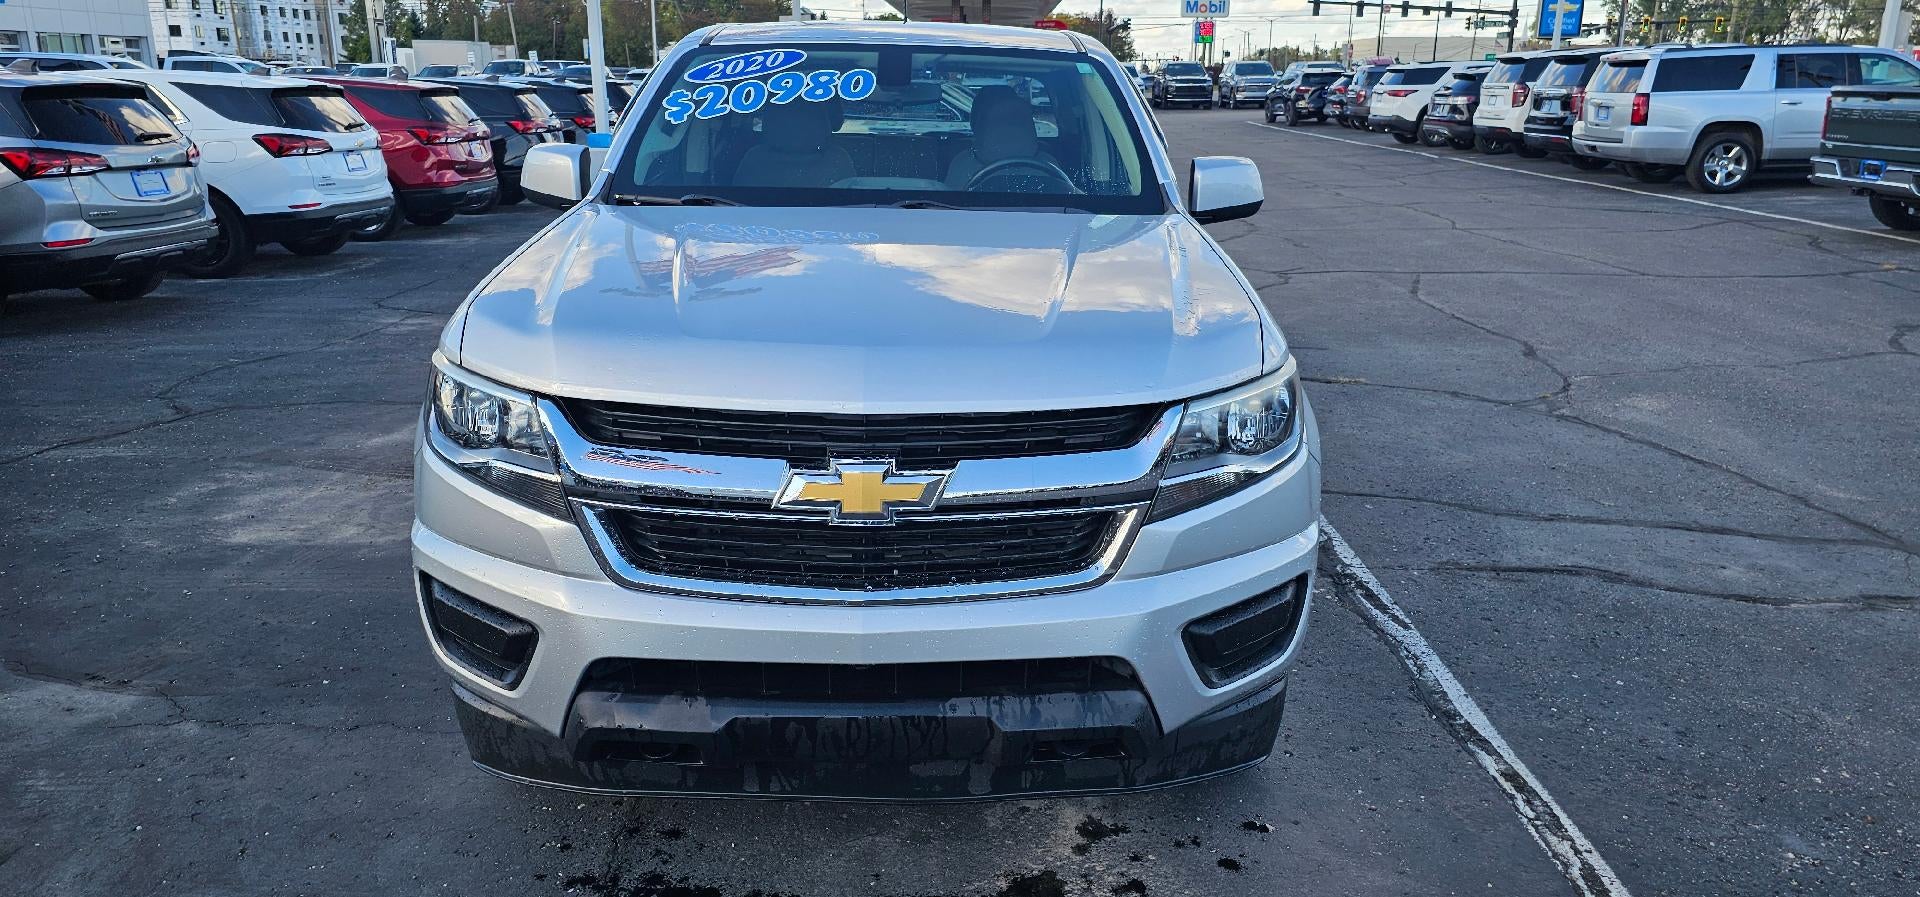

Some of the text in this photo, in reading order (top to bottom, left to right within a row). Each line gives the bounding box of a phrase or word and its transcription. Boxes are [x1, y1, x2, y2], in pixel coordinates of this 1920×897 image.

[1186, 0, 1226, 13] Mobil
[704, 51, 785, 80] 2020
[662, 69, 876, 124] $20980
[1831, 109, 1920, 121] CHEVROLE
